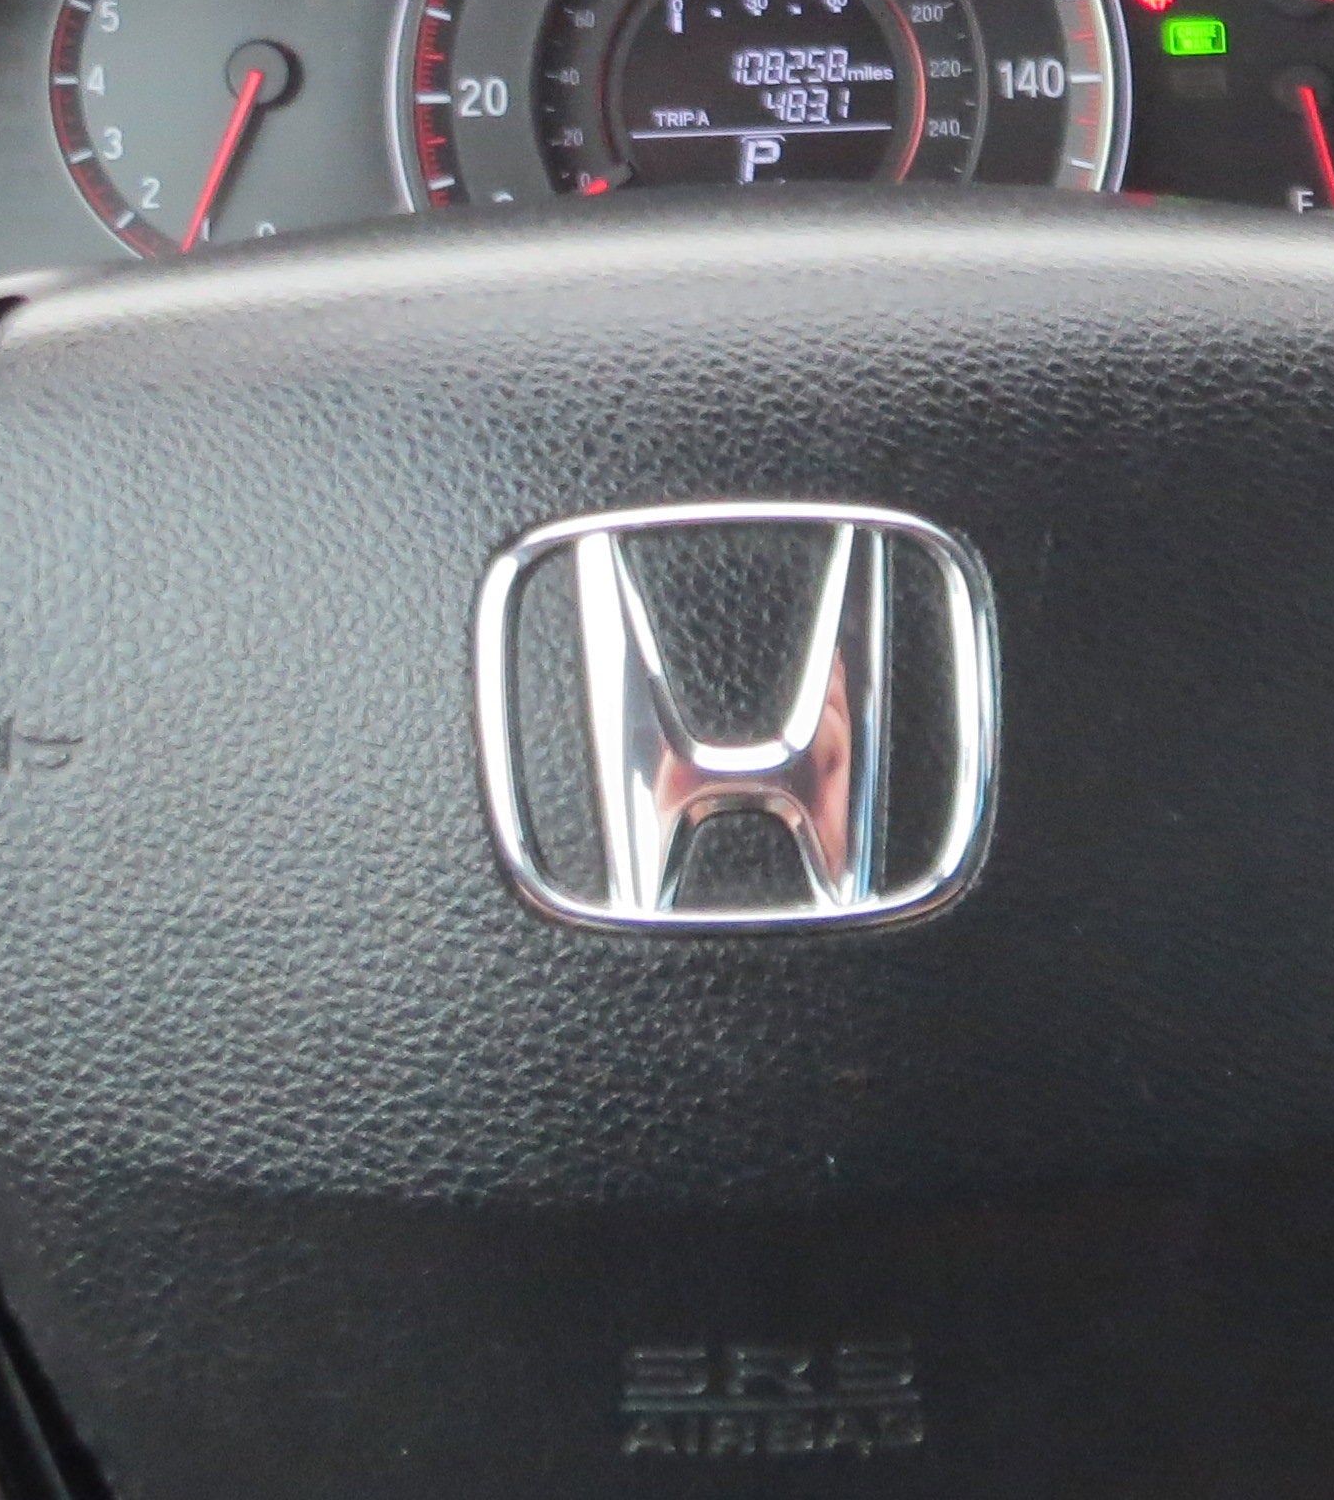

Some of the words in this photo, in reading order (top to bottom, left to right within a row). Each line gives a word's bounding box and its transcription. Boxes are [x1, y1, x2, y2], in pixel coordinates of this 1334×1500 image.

[98, 0, 121, 33] 5
[86, 66, 106, 96] 4
[732, 48, 848, 86] 108258
[848, 64, 894, 82] miles
[998, 59, 1065, 100] 140
[458, 76, 509, 117] 20
[652, 109, 695, 128] TRIP
[104, 128, 124, 160] 3
[740, 138, 783, 183] P
[141, 177, 161, 209] 2
